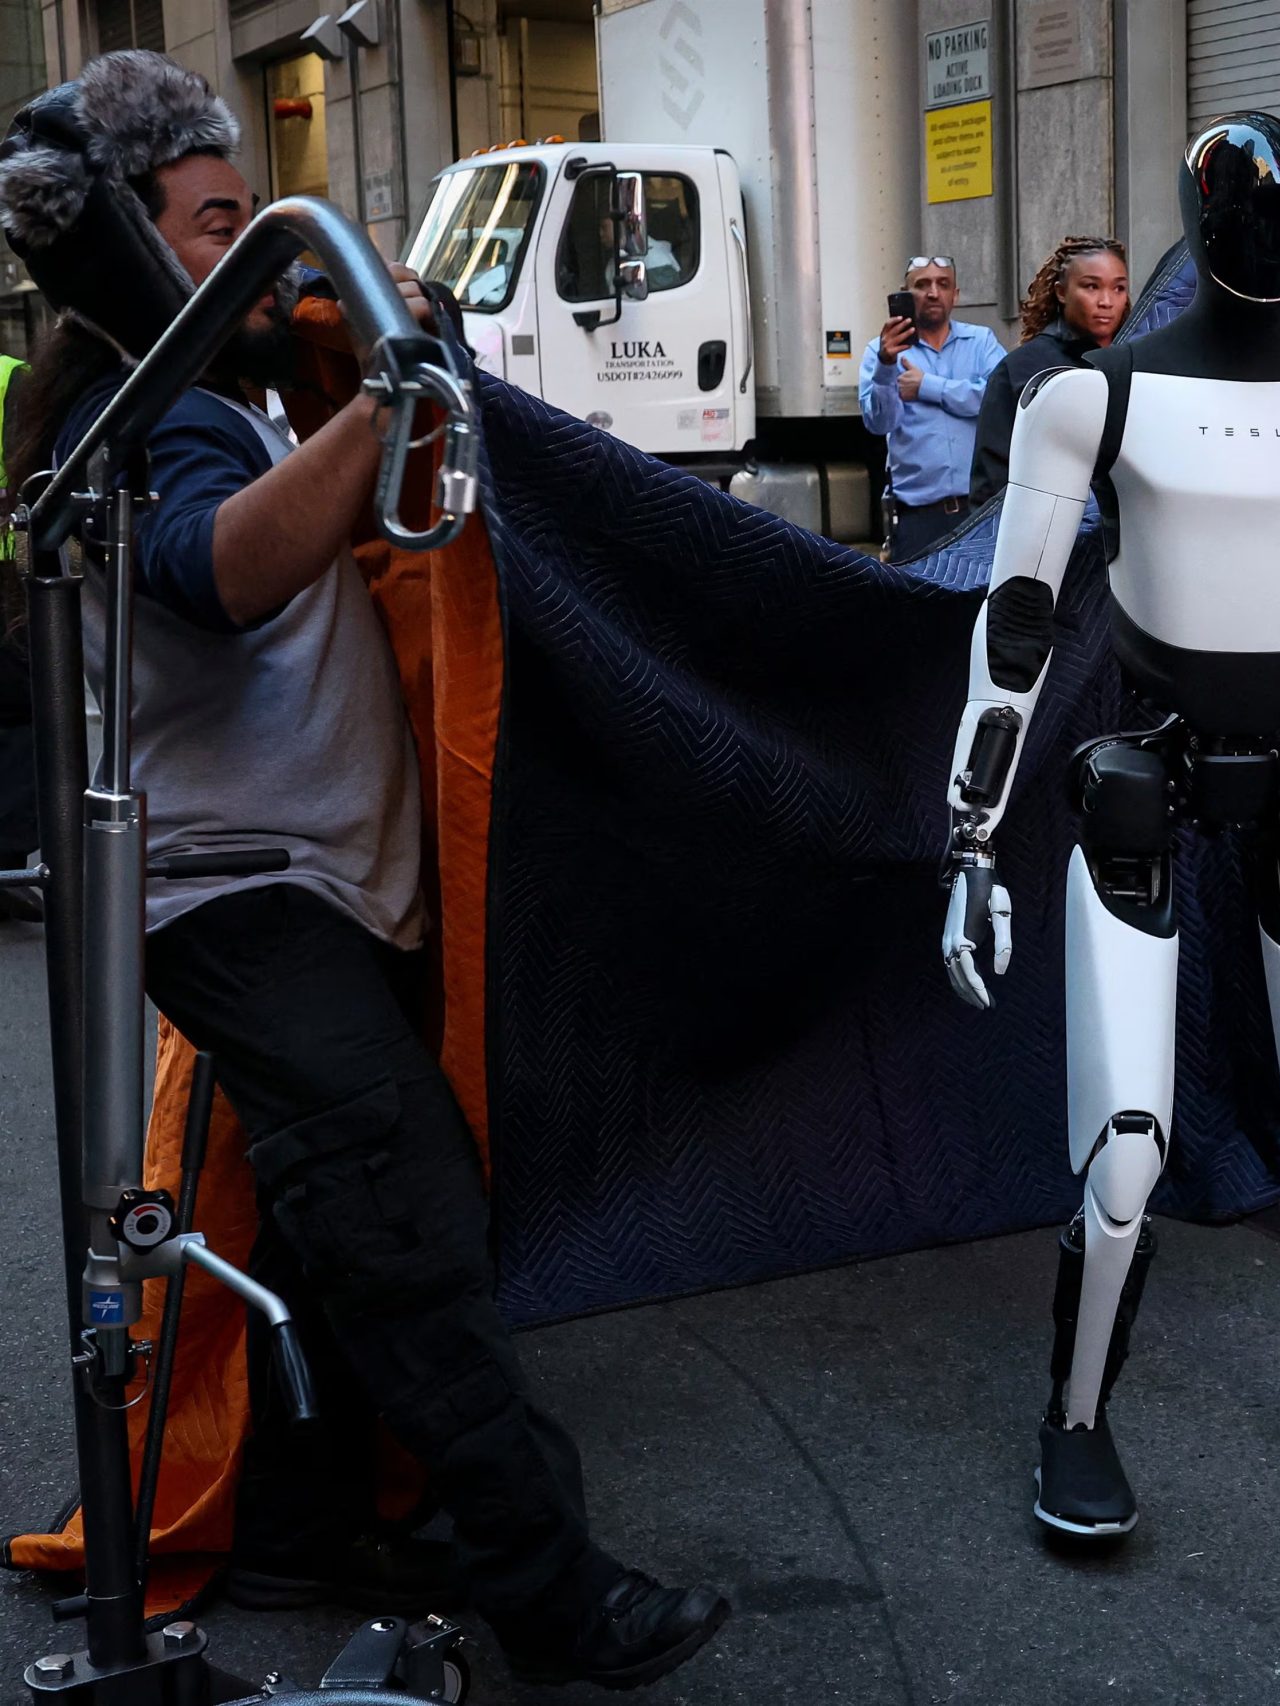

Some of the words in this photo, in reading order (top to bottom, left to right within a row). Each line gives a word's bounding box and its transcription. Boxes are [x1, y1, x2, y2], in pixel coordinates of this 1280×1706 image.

[928, 38, 942, 61] NO
[945, 27, 987, 57] PARKING
[946, 60, 969, 78] ACTIVE
[933, 79, 962, 98] LOADING
[964, 74, 983, 93] DOCK
[611, 341, 666, 359] LUKA
[605, 360, 675, 369] TRANSPORTATION
